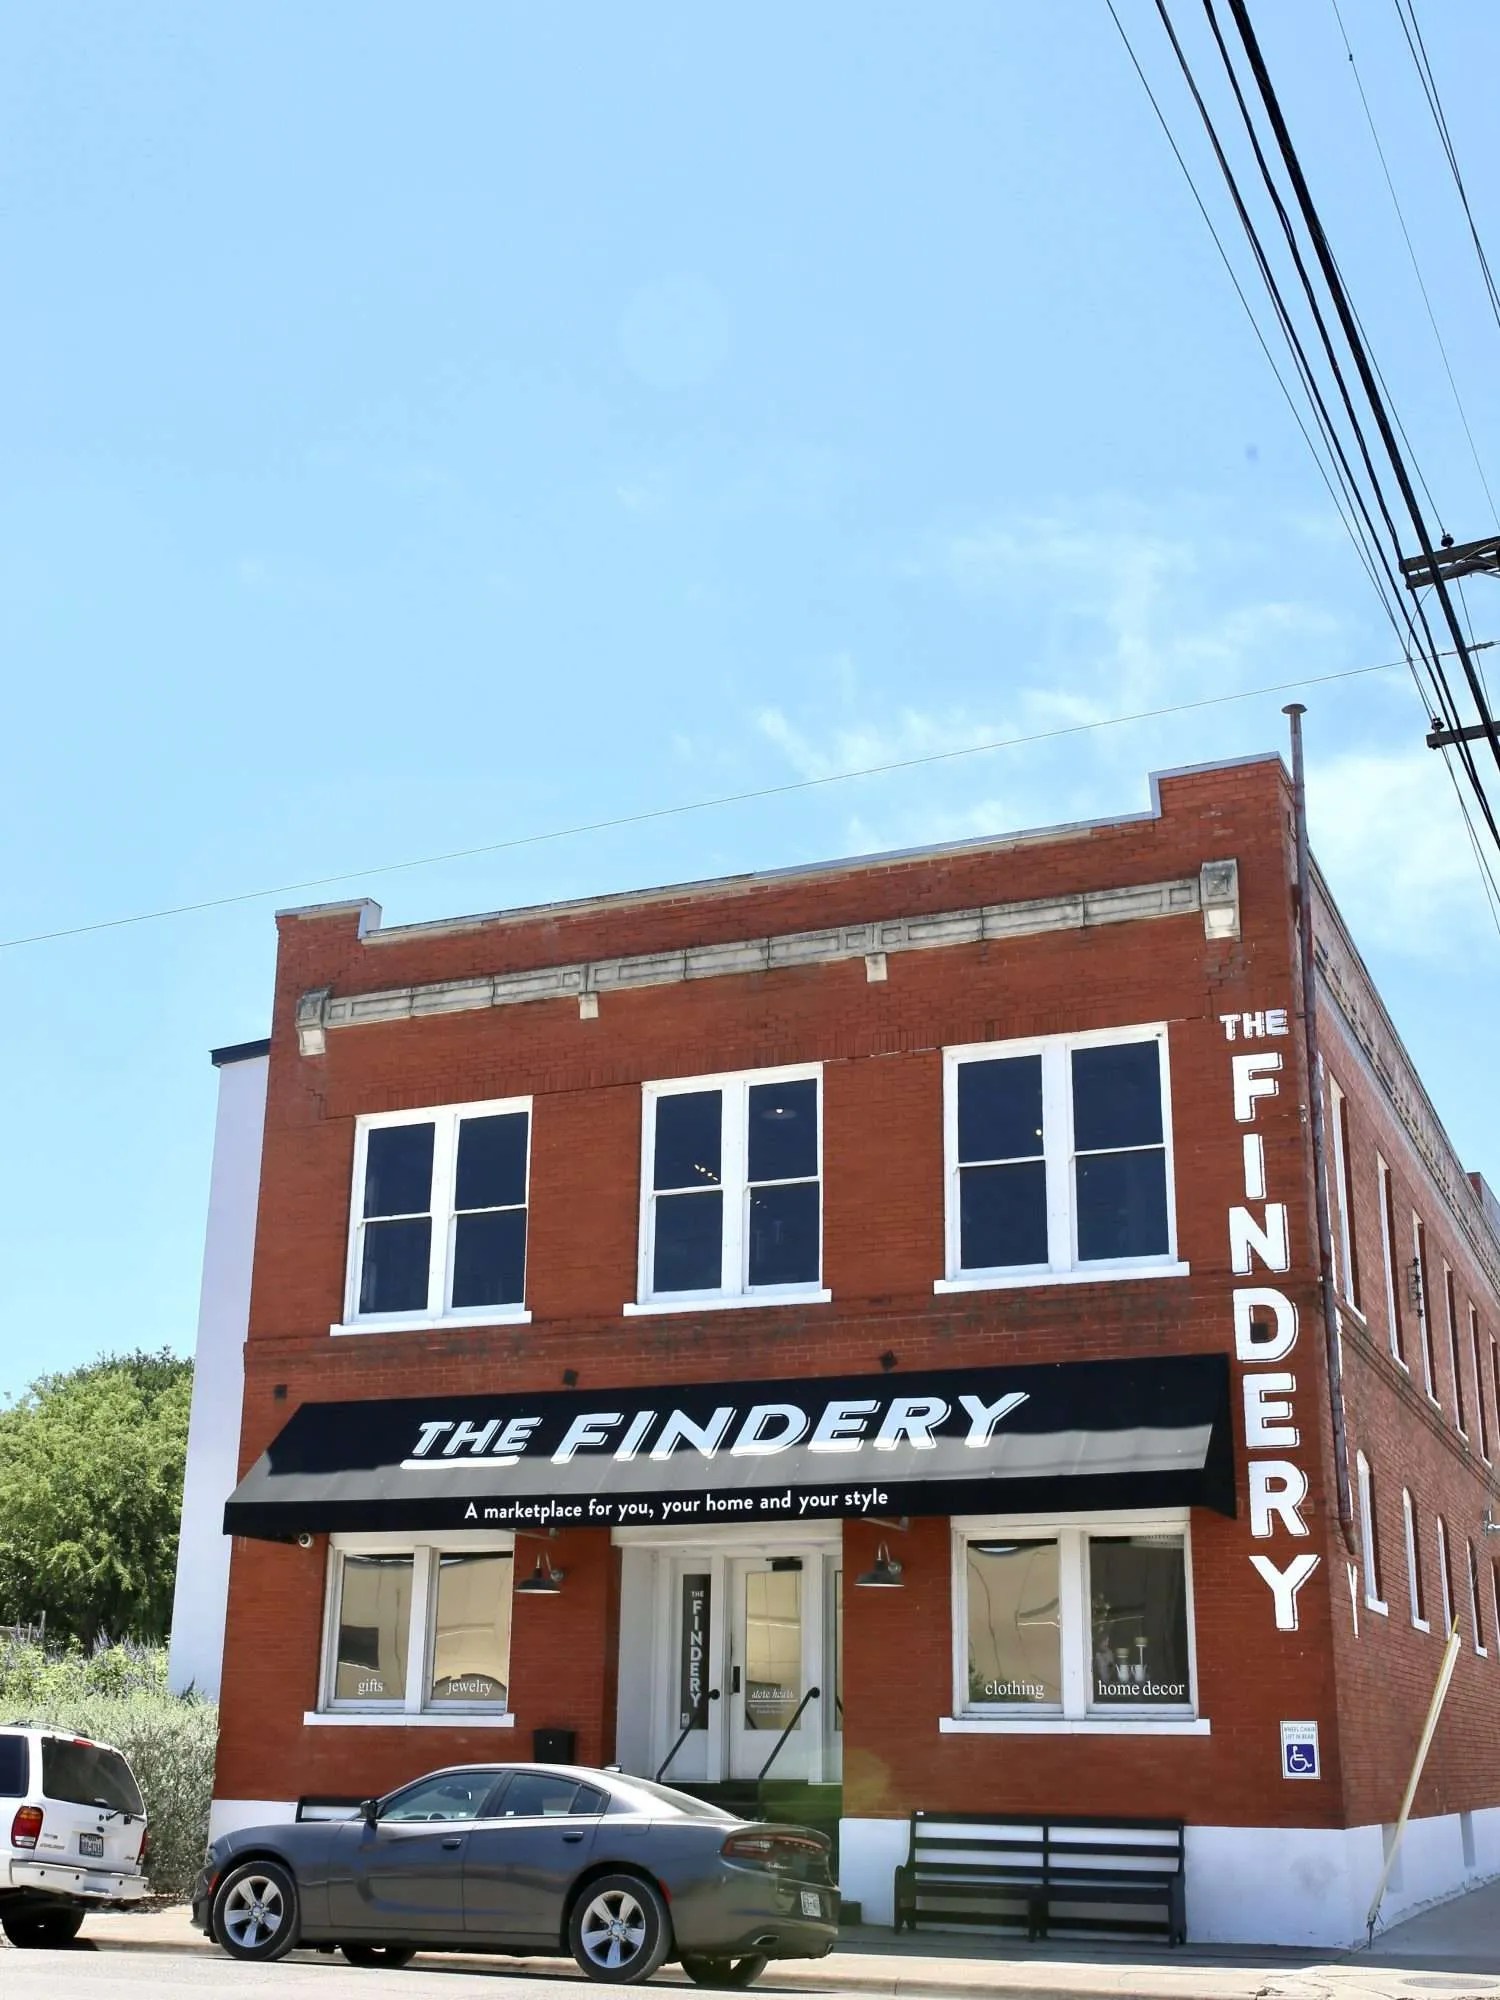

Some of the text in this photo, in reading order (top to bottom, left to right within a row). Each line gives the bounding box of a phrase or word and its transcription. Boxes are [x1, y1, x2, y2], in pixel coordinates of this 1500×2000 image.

[1219, 1008, 1289, 1041] THE
[1229, 1052, 1321, 1632] FINDERY
[411, 1391, 1031, 1465] THE FINDERY
[464, 1487, 888, 1524] A marketplace for you, your home and your style
[691, 1590, 704, 1598] THE
[689, 1600, 703, 1709] FINDERY
[357, 1678, 384, 1695] gifts
[446, 1679, 493, 1696] jewelry
[985, 1680, 1045, 1699] clothing
[1098, 1679, 1185, 1696] home decor
